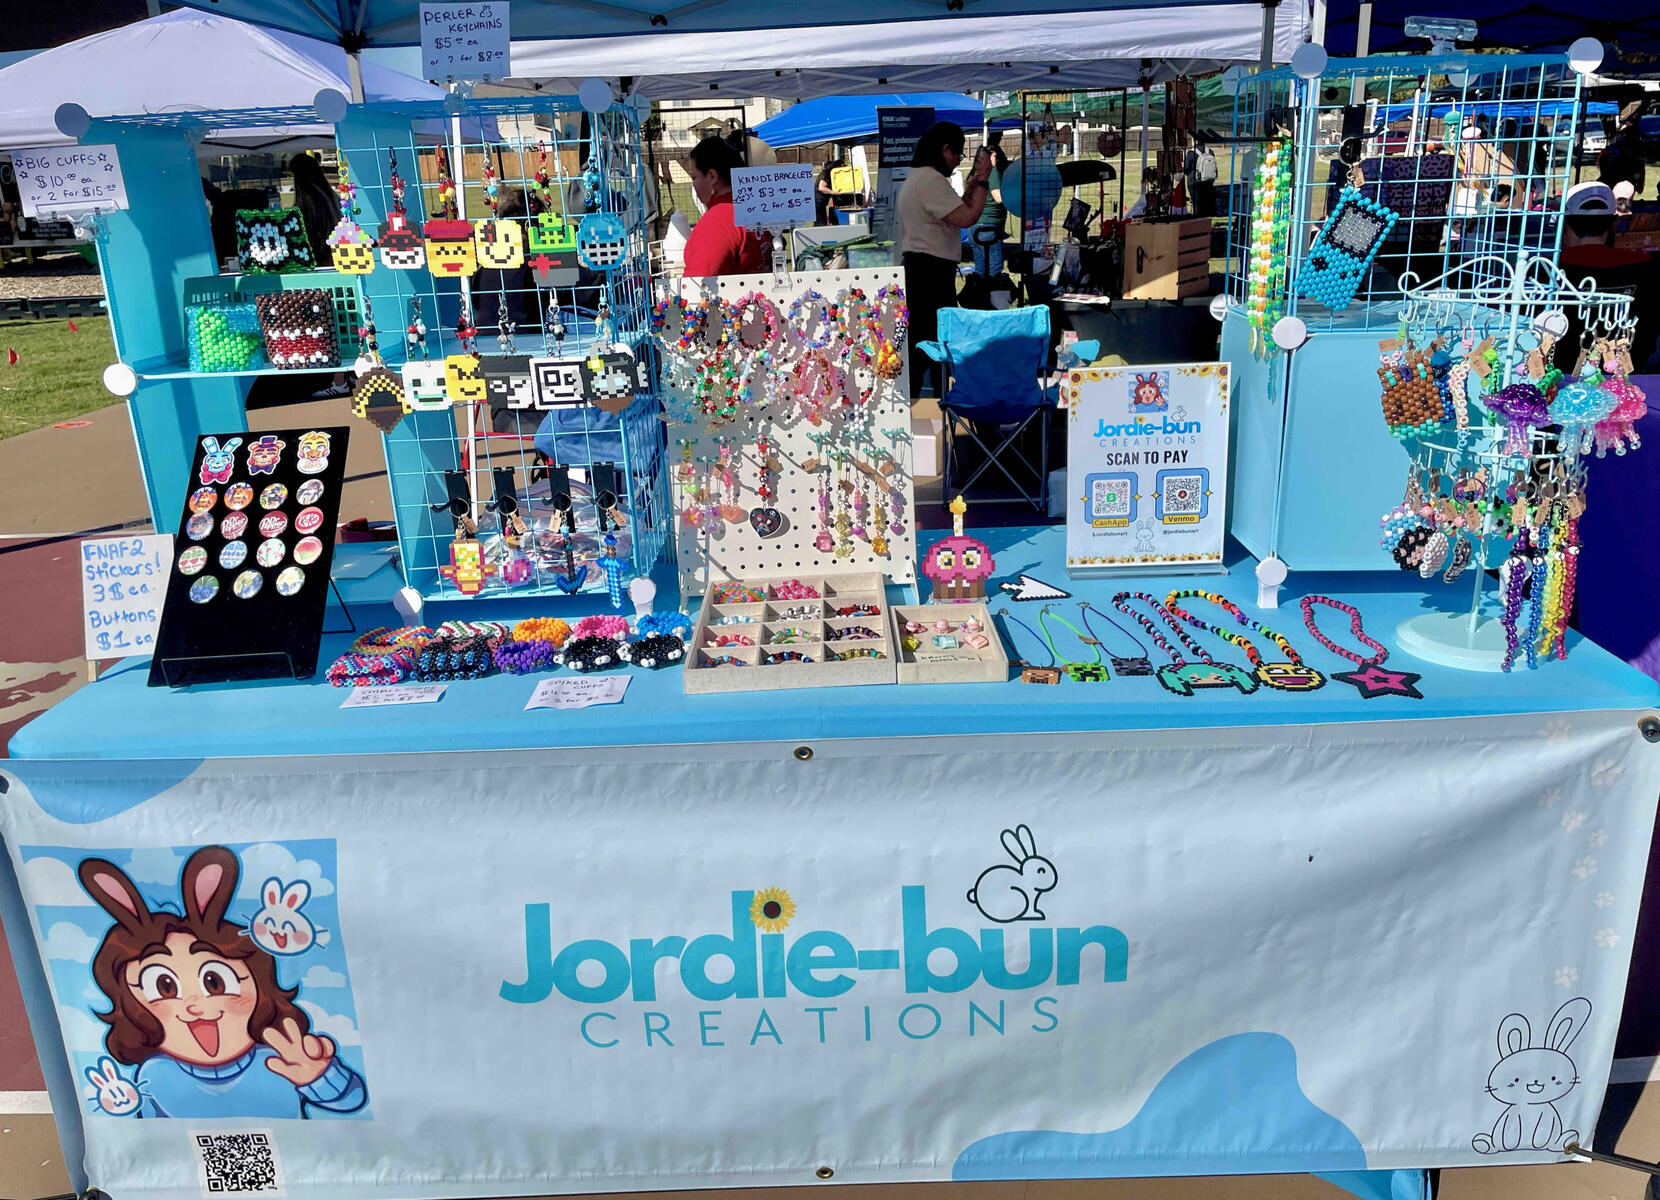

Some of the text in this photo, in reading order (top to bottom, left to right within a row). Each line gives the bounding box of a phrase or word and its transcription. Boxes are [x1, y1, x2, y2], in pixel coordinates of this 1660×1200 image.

[424, 8, 475, 26] PERLER
[448, 18, 503, 33] KEYCHAINS
[26, 154, 96, 169] BIG CUFFS
[738, 170, 813, 185] KANDI BRACELETS
[48, 191, 57, 201] 2
[761, 203, 769, 212] 2
[1093, 415, 1201, 438] Jordie-bun
[1099, 435, 1196, 448] CREATIONS
[1106, 450, 1188, 466] SCAN TO PAY
[1094, 518, 1128, 527] CashApp
[1168, 515, 1195, 523] Venmo
[88, 609, 156, 629] Buttons
[96, 630, 131, 651] $1
[499, 885, 1129, 1004] Jordie-bun
[580, 996, 1058, 1048] CREATIONS
